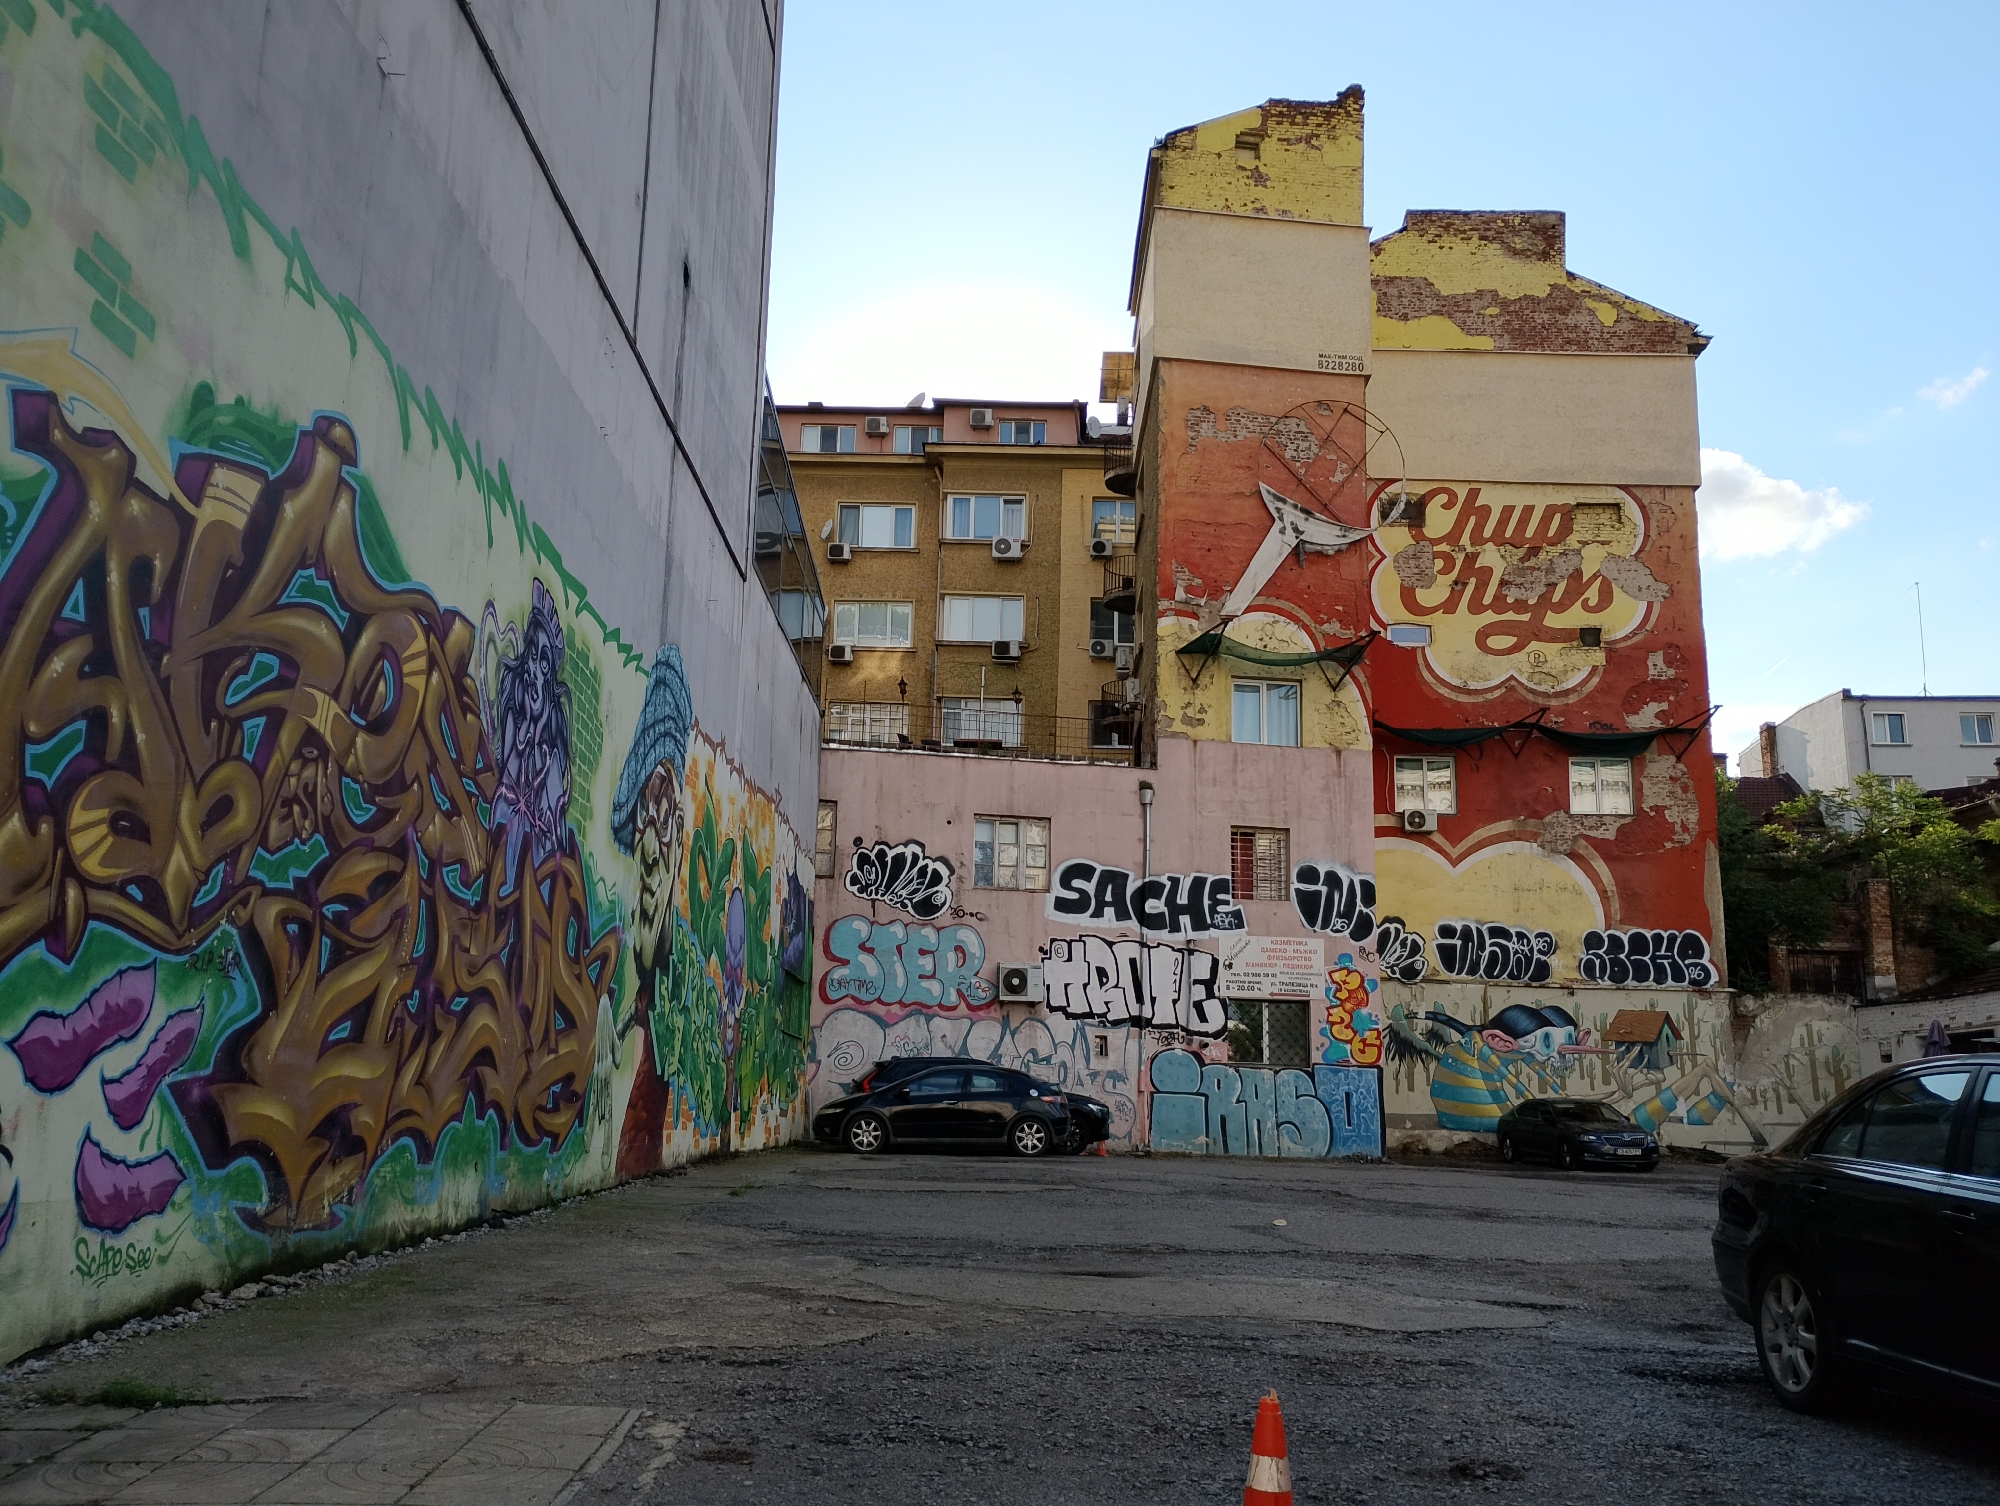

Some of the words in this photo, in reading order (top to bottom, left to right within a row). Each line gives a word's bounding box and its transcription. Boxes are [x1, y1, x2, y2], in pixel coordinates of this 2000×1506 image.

[1317, 359, 1364, 372] 8228280
[1047, 858, 1248, 937] SACHE
[1279, 981, 1309, 989] ТРАПЕЗИЦА
